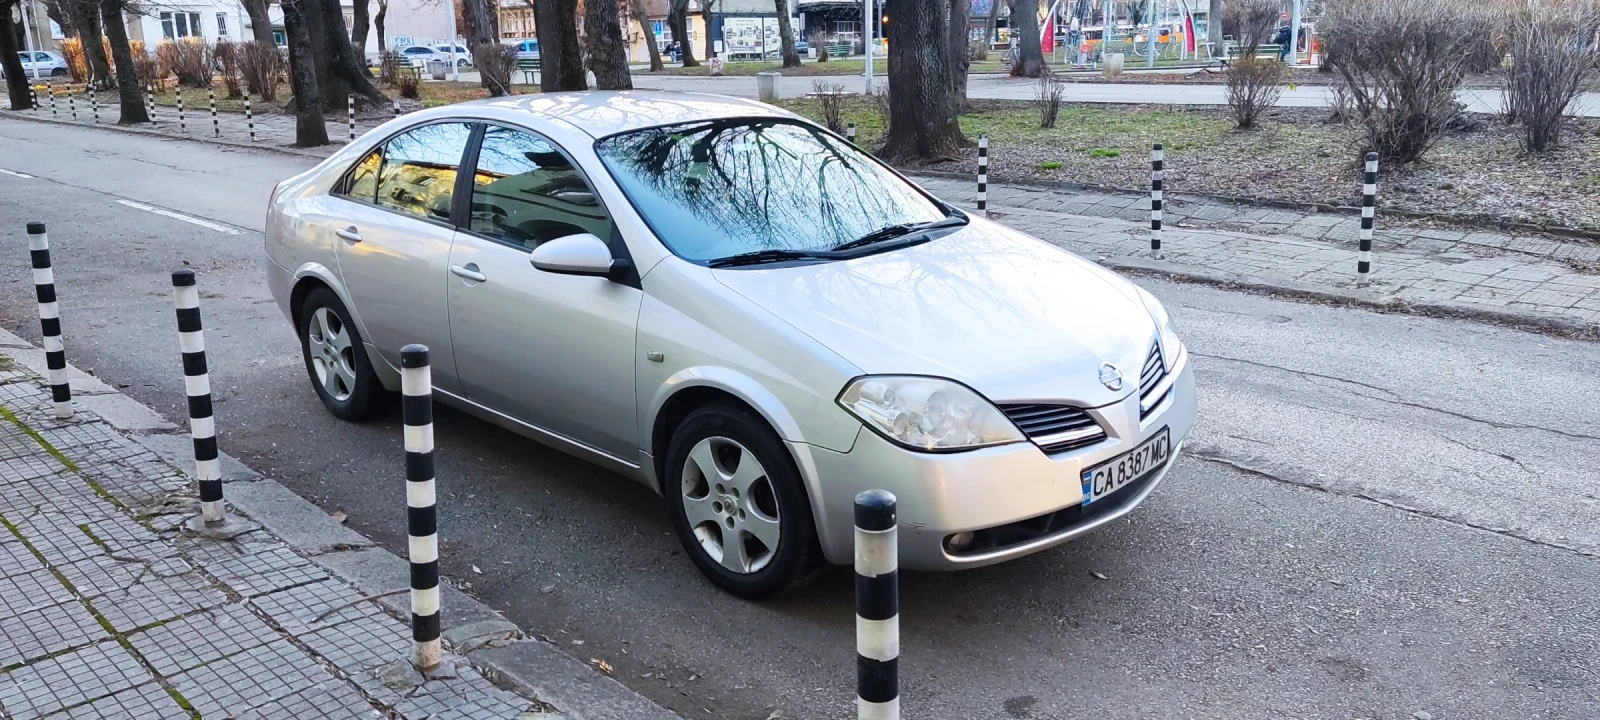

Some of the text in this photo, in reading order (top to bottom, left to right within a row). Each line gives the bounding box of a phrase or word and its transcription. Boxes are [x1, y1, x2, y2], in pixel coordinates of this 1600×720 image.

[1094, 437, 1166, 496] CA 8387 MC
